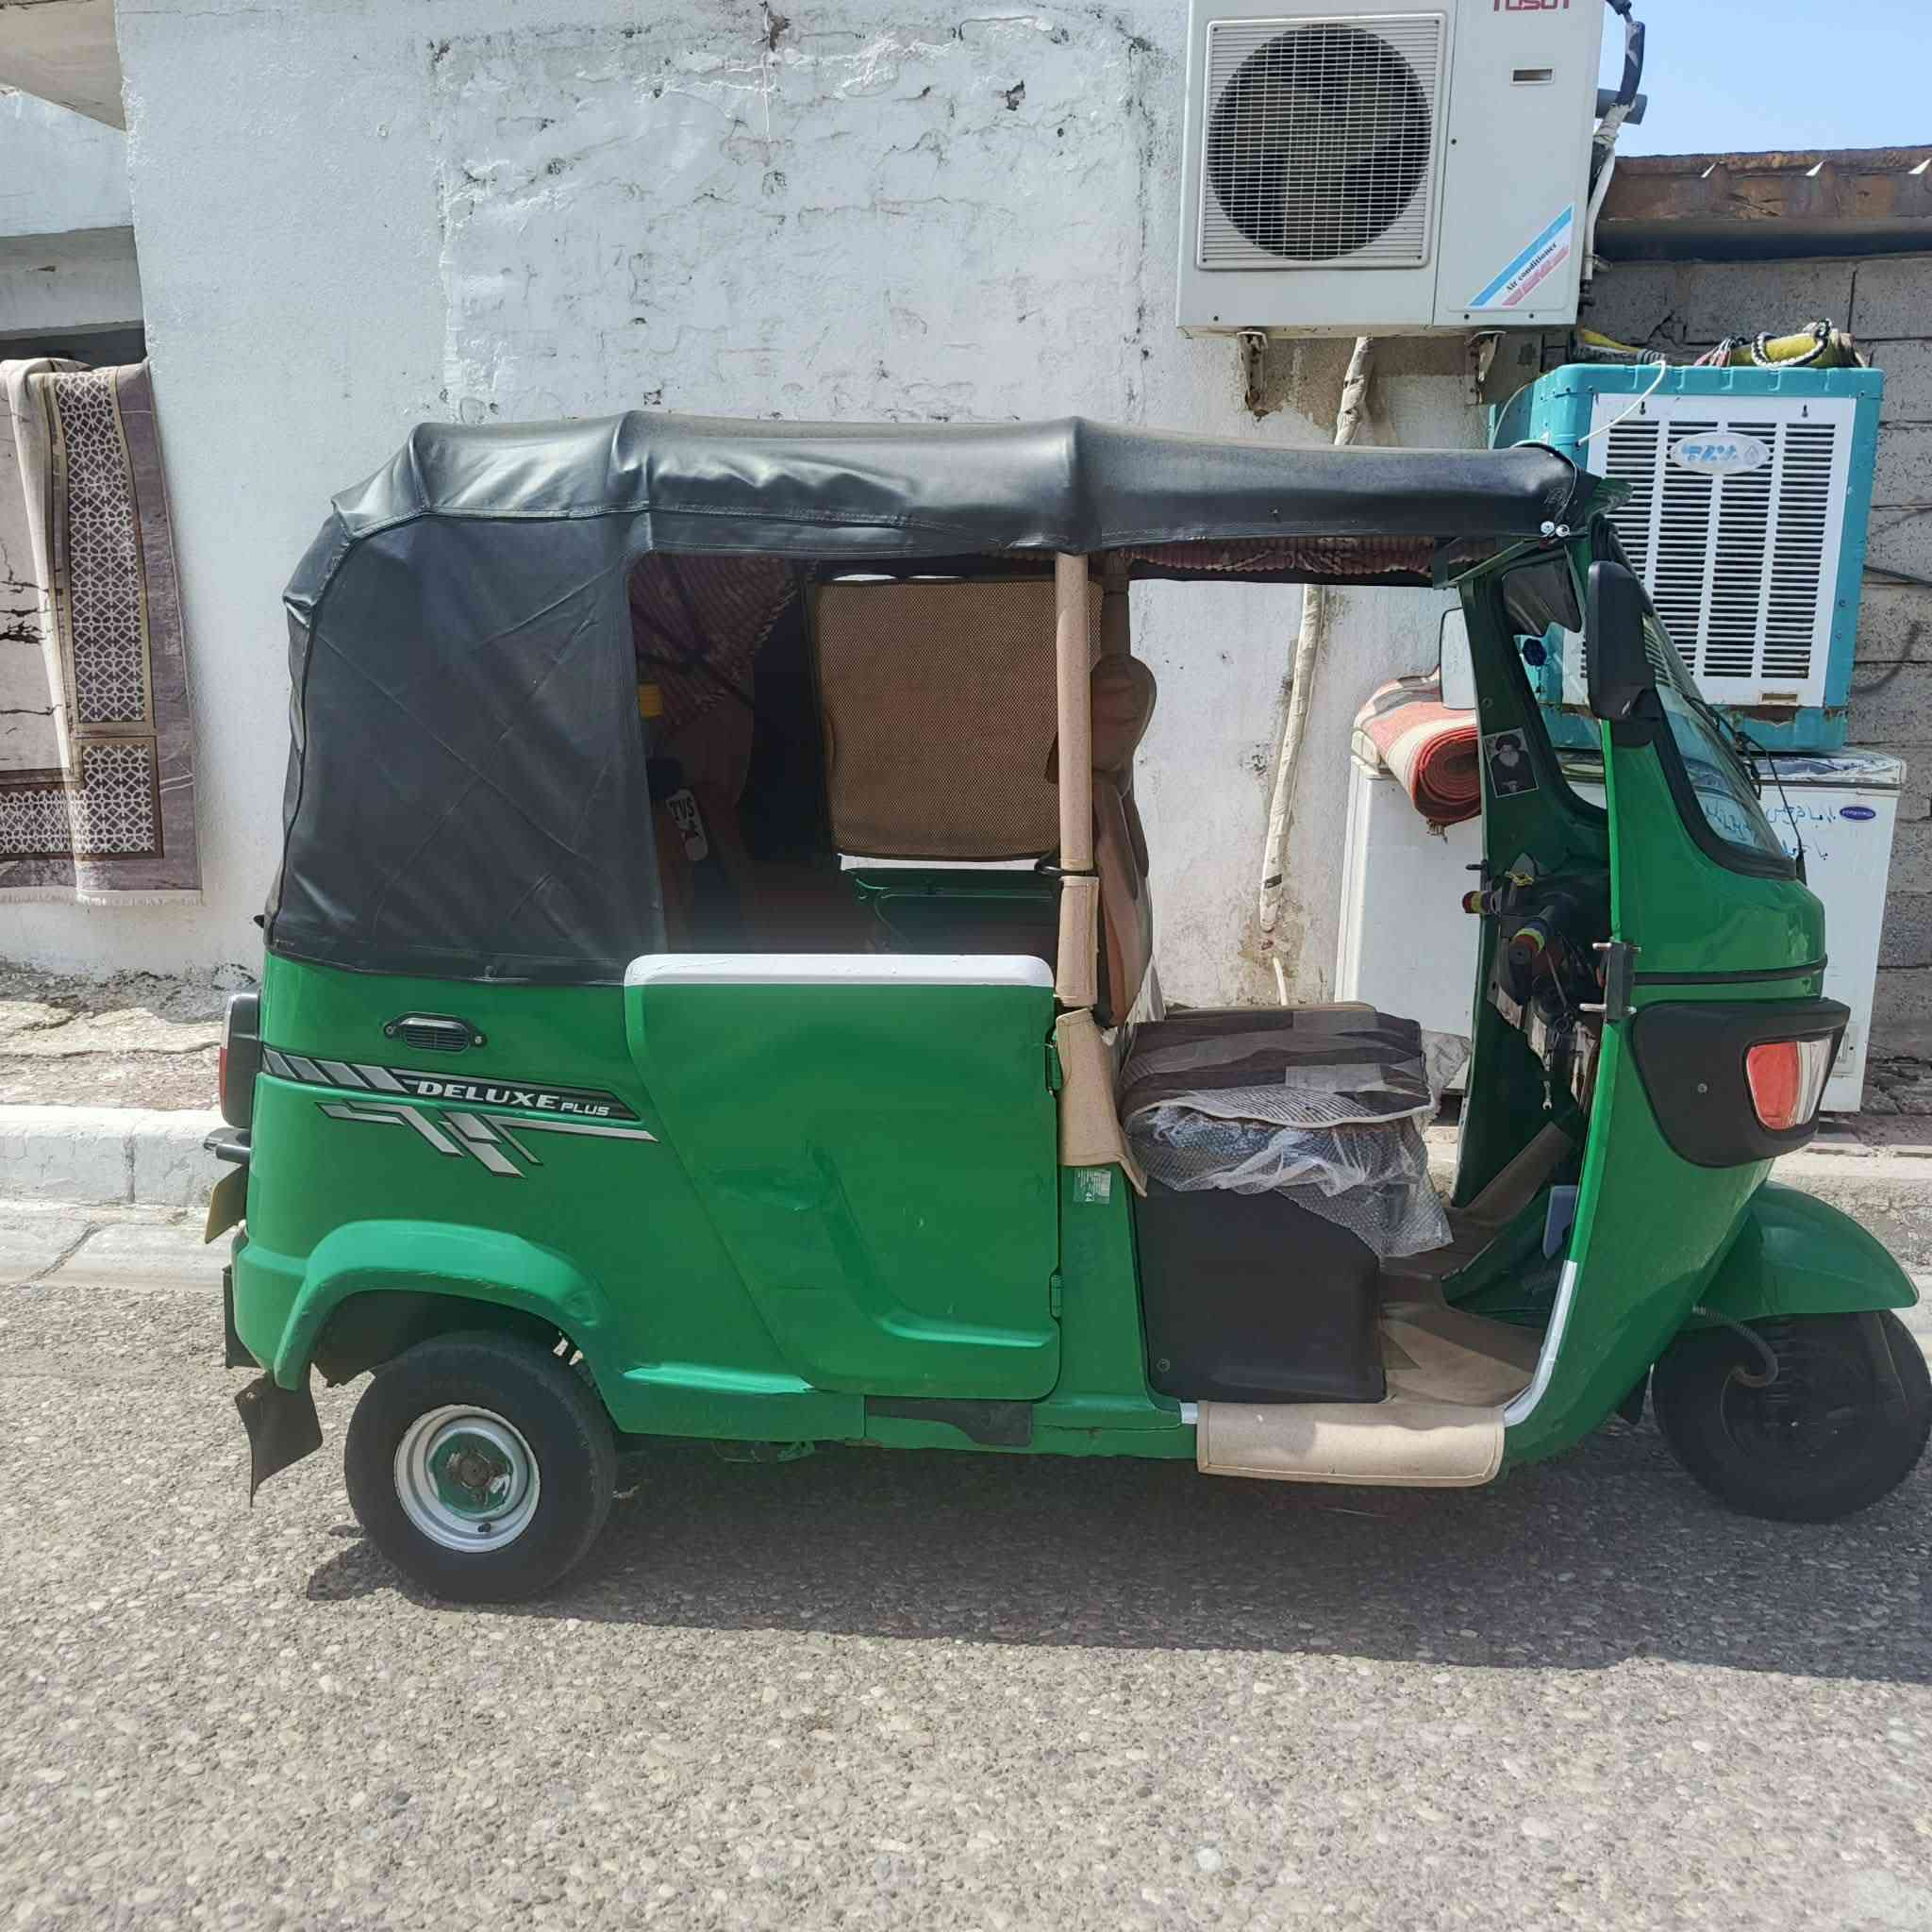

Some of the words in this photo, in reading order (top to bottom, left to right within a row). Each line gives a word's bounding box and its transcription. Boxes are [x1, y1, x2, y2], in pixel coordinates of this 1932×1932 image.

[1517, 242, 1557, 281] conditioner
[669, 797, 695, 820] TVS
[417, 1081, 559, 1109] DELUXE
[560, 1102, 610, 1117] PLUS
